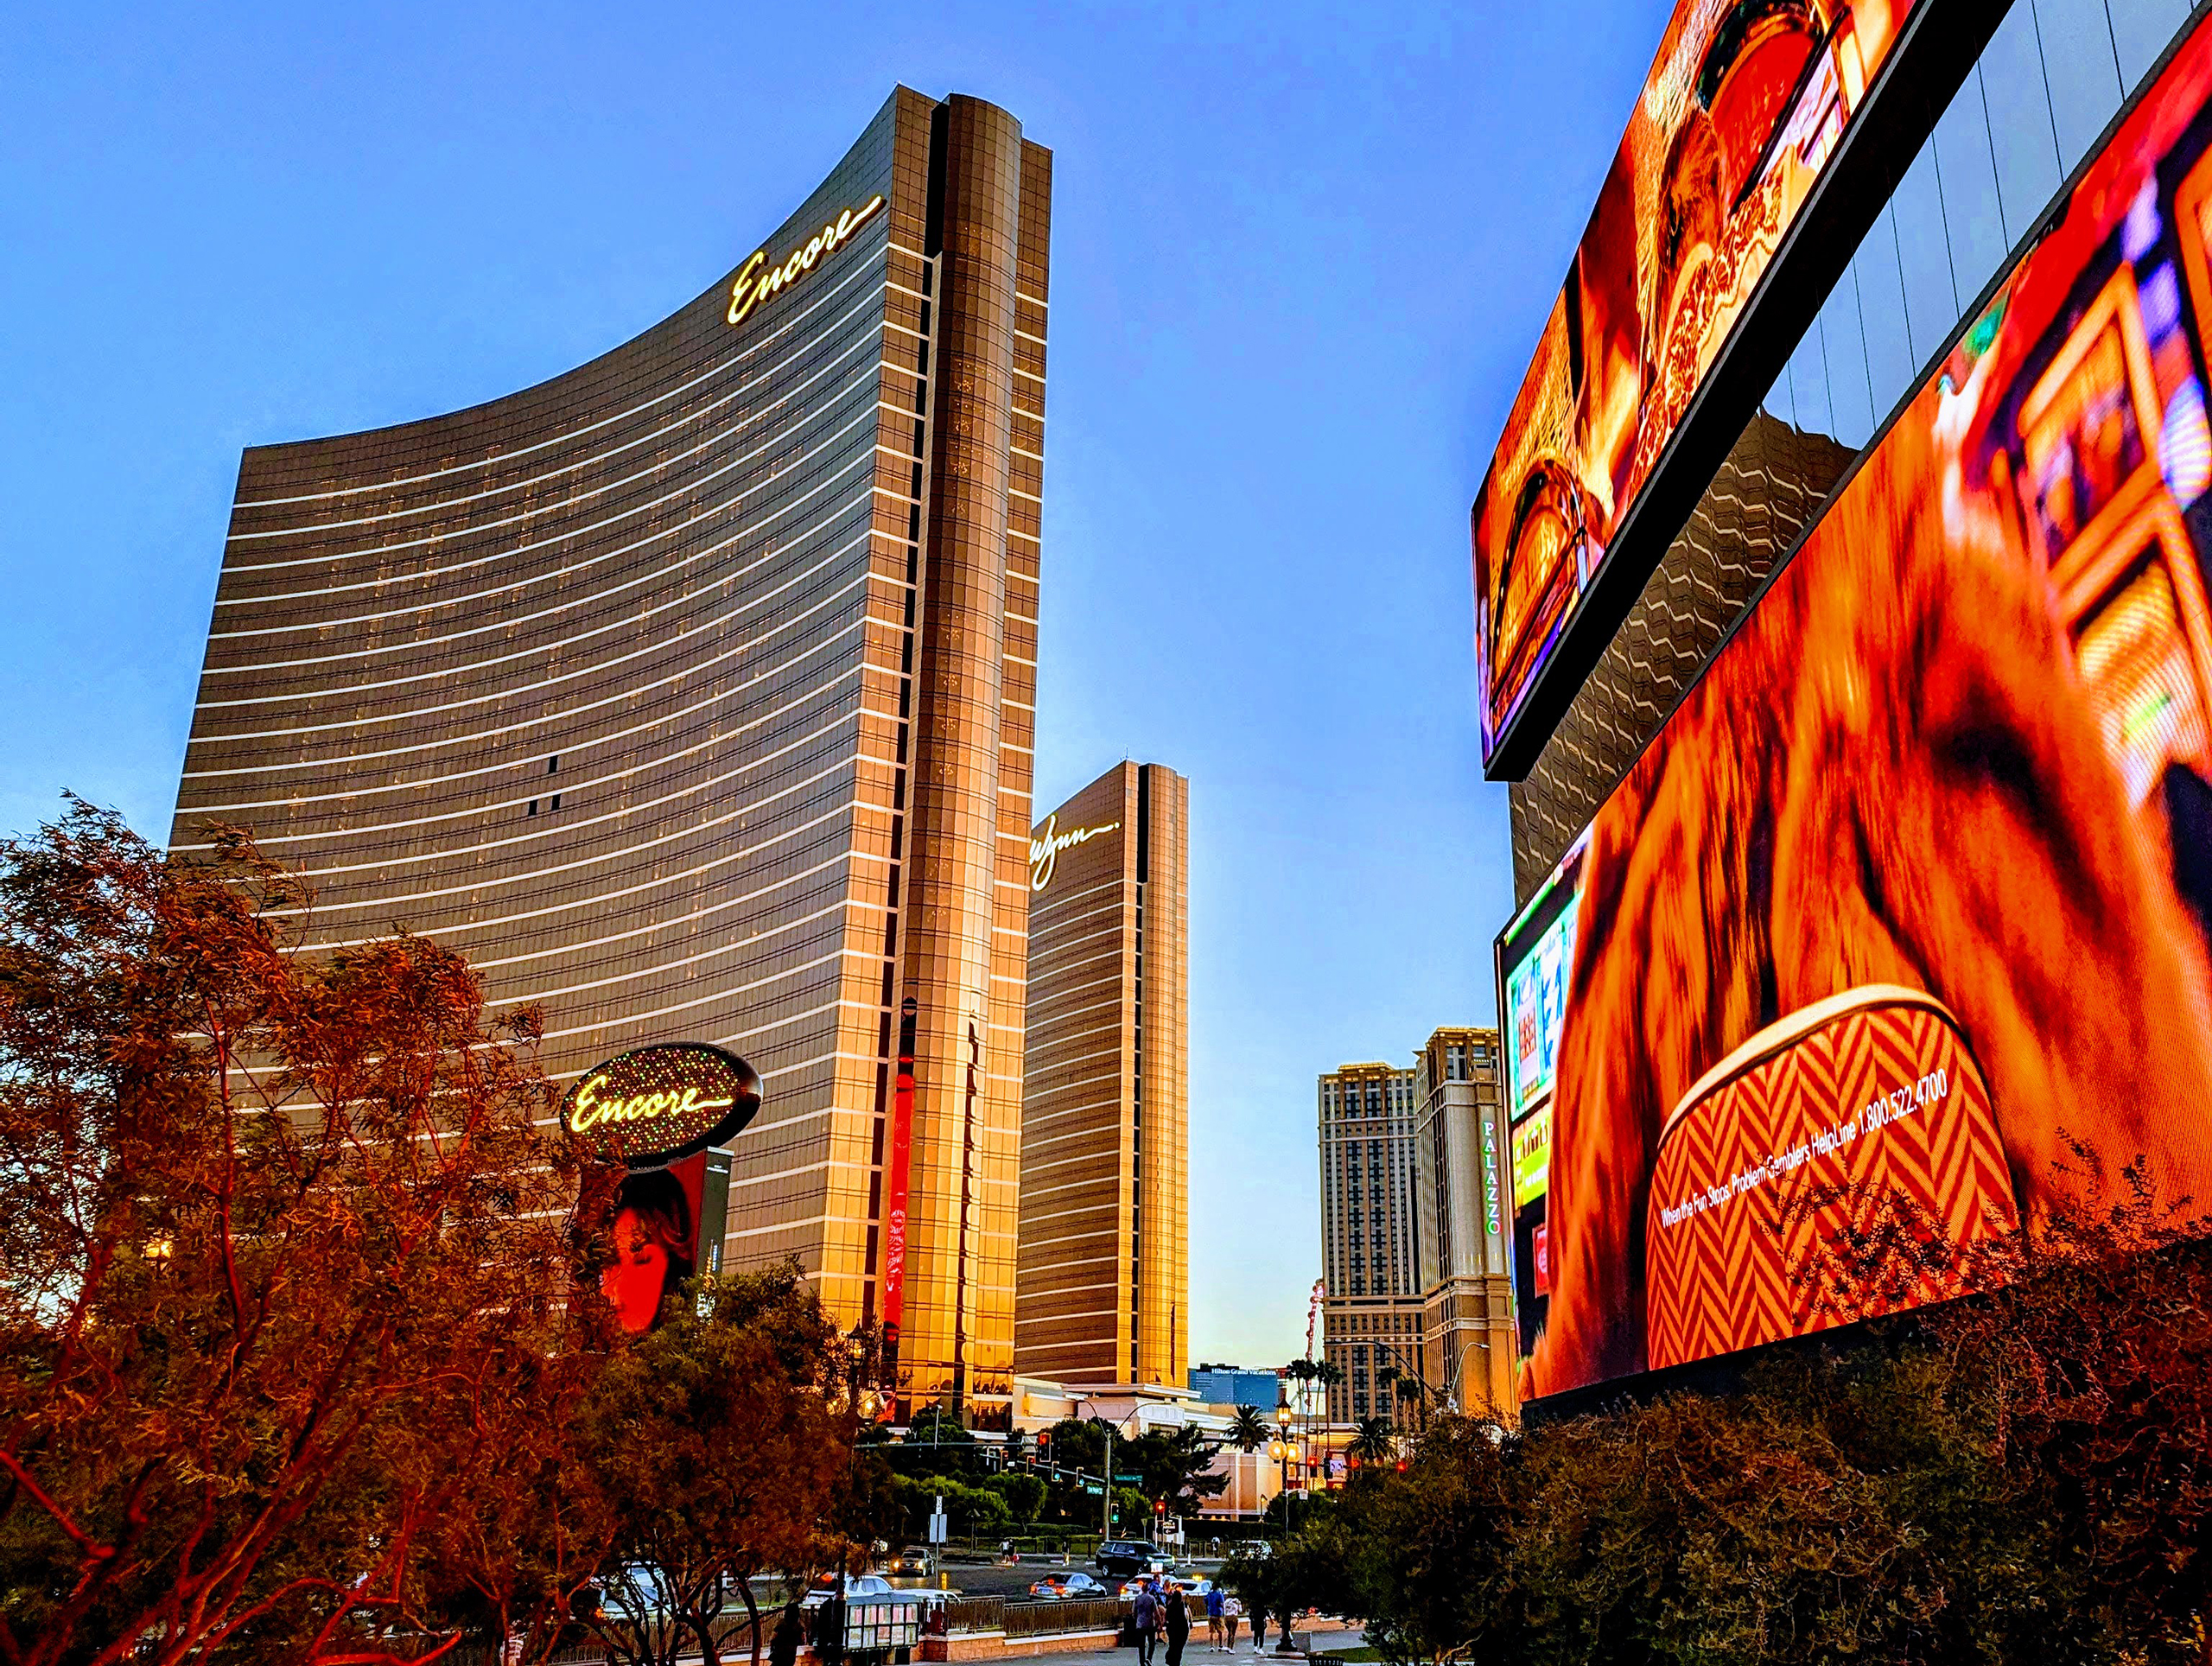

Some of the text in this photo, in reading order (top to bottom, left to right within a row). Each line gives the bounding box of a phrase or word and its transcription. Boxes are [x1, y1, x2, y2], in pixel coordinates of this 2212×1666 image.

[728, 195, 883, 325] Encore
[571, 1075, 733, 1132] Encore
[1661, 1205, 1681, 1229] When
[1681, 1198, 1694, 1219] the
[1694, 1192, 1707, 1214] Fun
[1731, 1164, 1766, 1196] Problem
[1766, 1142, 1811, 1180] Gamblers
[1811, 1121, 1856, 1159] HelpLine
[1858, 1068, 1948, 1135] 1.800.522.4700
[1484, 1122, 1501, 1235] PALAZZO
